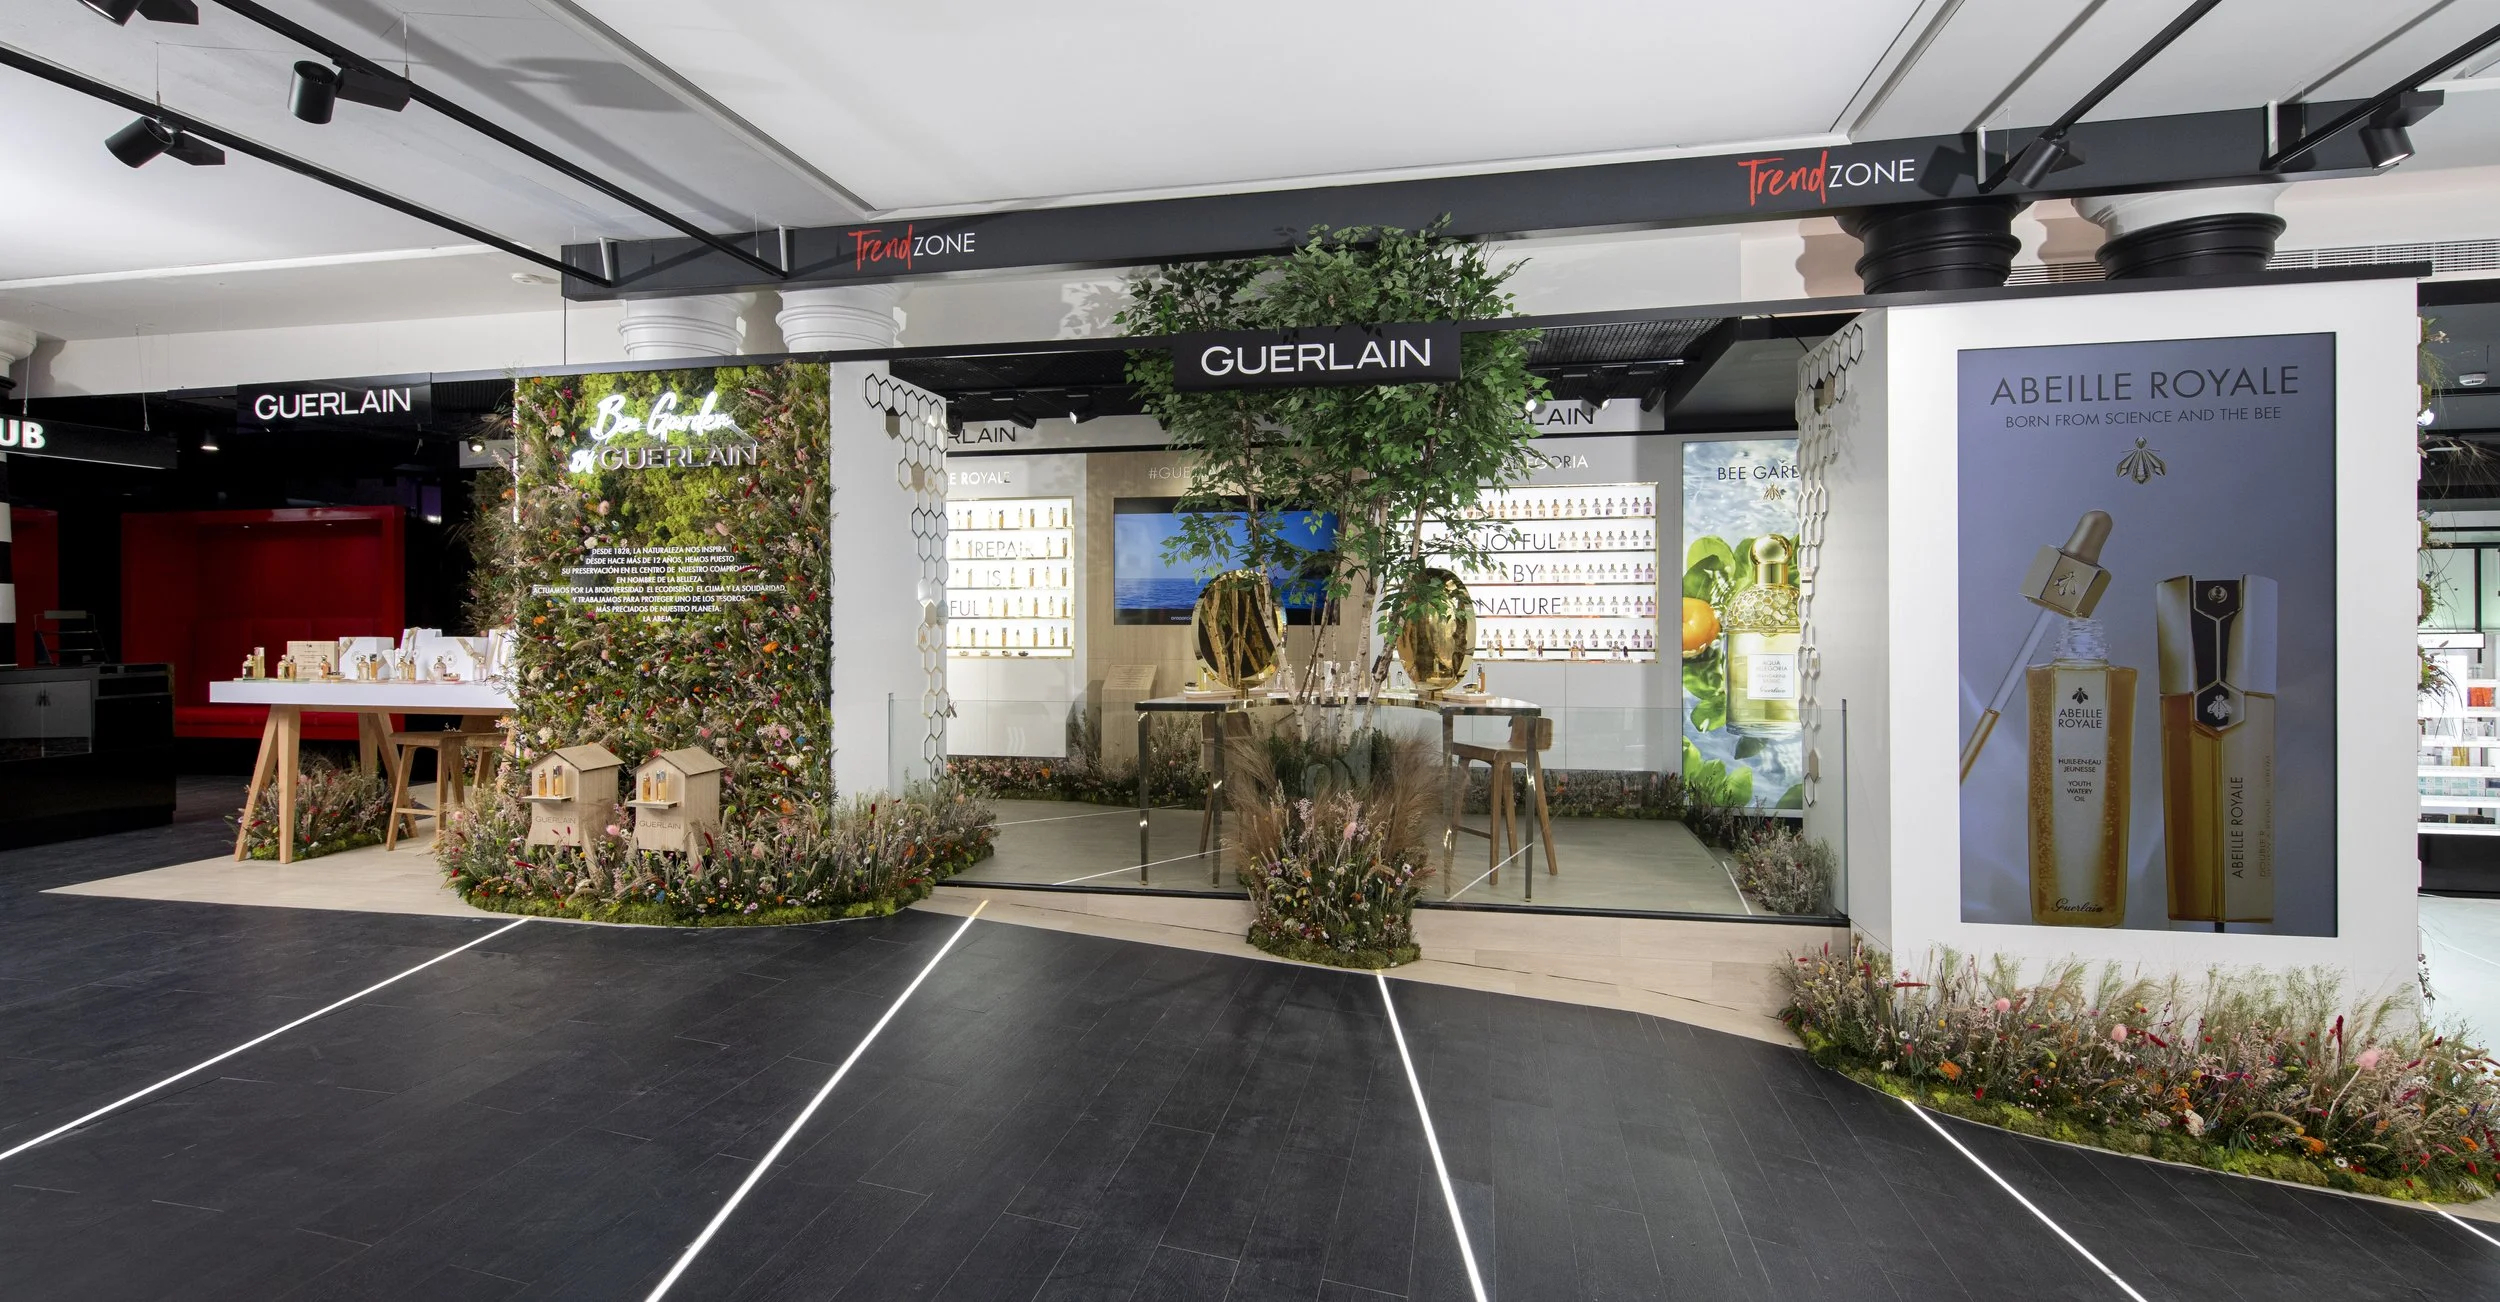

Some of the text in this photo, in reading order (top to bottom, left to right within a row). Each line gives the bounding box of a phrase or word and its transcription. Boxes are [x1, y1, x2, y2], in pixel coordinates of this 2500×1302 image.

[1738, 149, 1915, 207] Trend ZONE
[848, 224, 975, 272] Trend ZONE
[1201, 338, 1431, 376] GUERLAIN
[1989, 365, 2300, 405] ABEILLE ROYALE
[254, 388, 411, 420] GUERLAIN
[2006, 406, 2282, 428] BORN FROM SCIENCE AND THE BEE
[600, 443, 757, 471] GUERLAIN
[961, 472, 1011, 485] ROYALE
[1717, 466, 1747, 480] BEE
[642, 546, 684, 554] NATURALEZA
[1481, 533, 1557, 551] JOYFUL
[626, 556, 641, 564] MÁS
[710, 555, 734, 563] PUESTO
[572, 566, 619, 574] PRESERVACIÓN
[1513, 564, 1539, 583] BY
[533, 586, 570, 594] ACTUAMOS
[596, 605, 610, 613] MÁS
[1479, 597, 1561, 615] NATURE
[2059, 708, 2102, 718] ABEILLE
[2058, 719, 2102, 729] ROYALE
[639, 820, 681, 829] GUERLAIN
[2230, 776, 2244, 879] ABEILLE ROYALE
